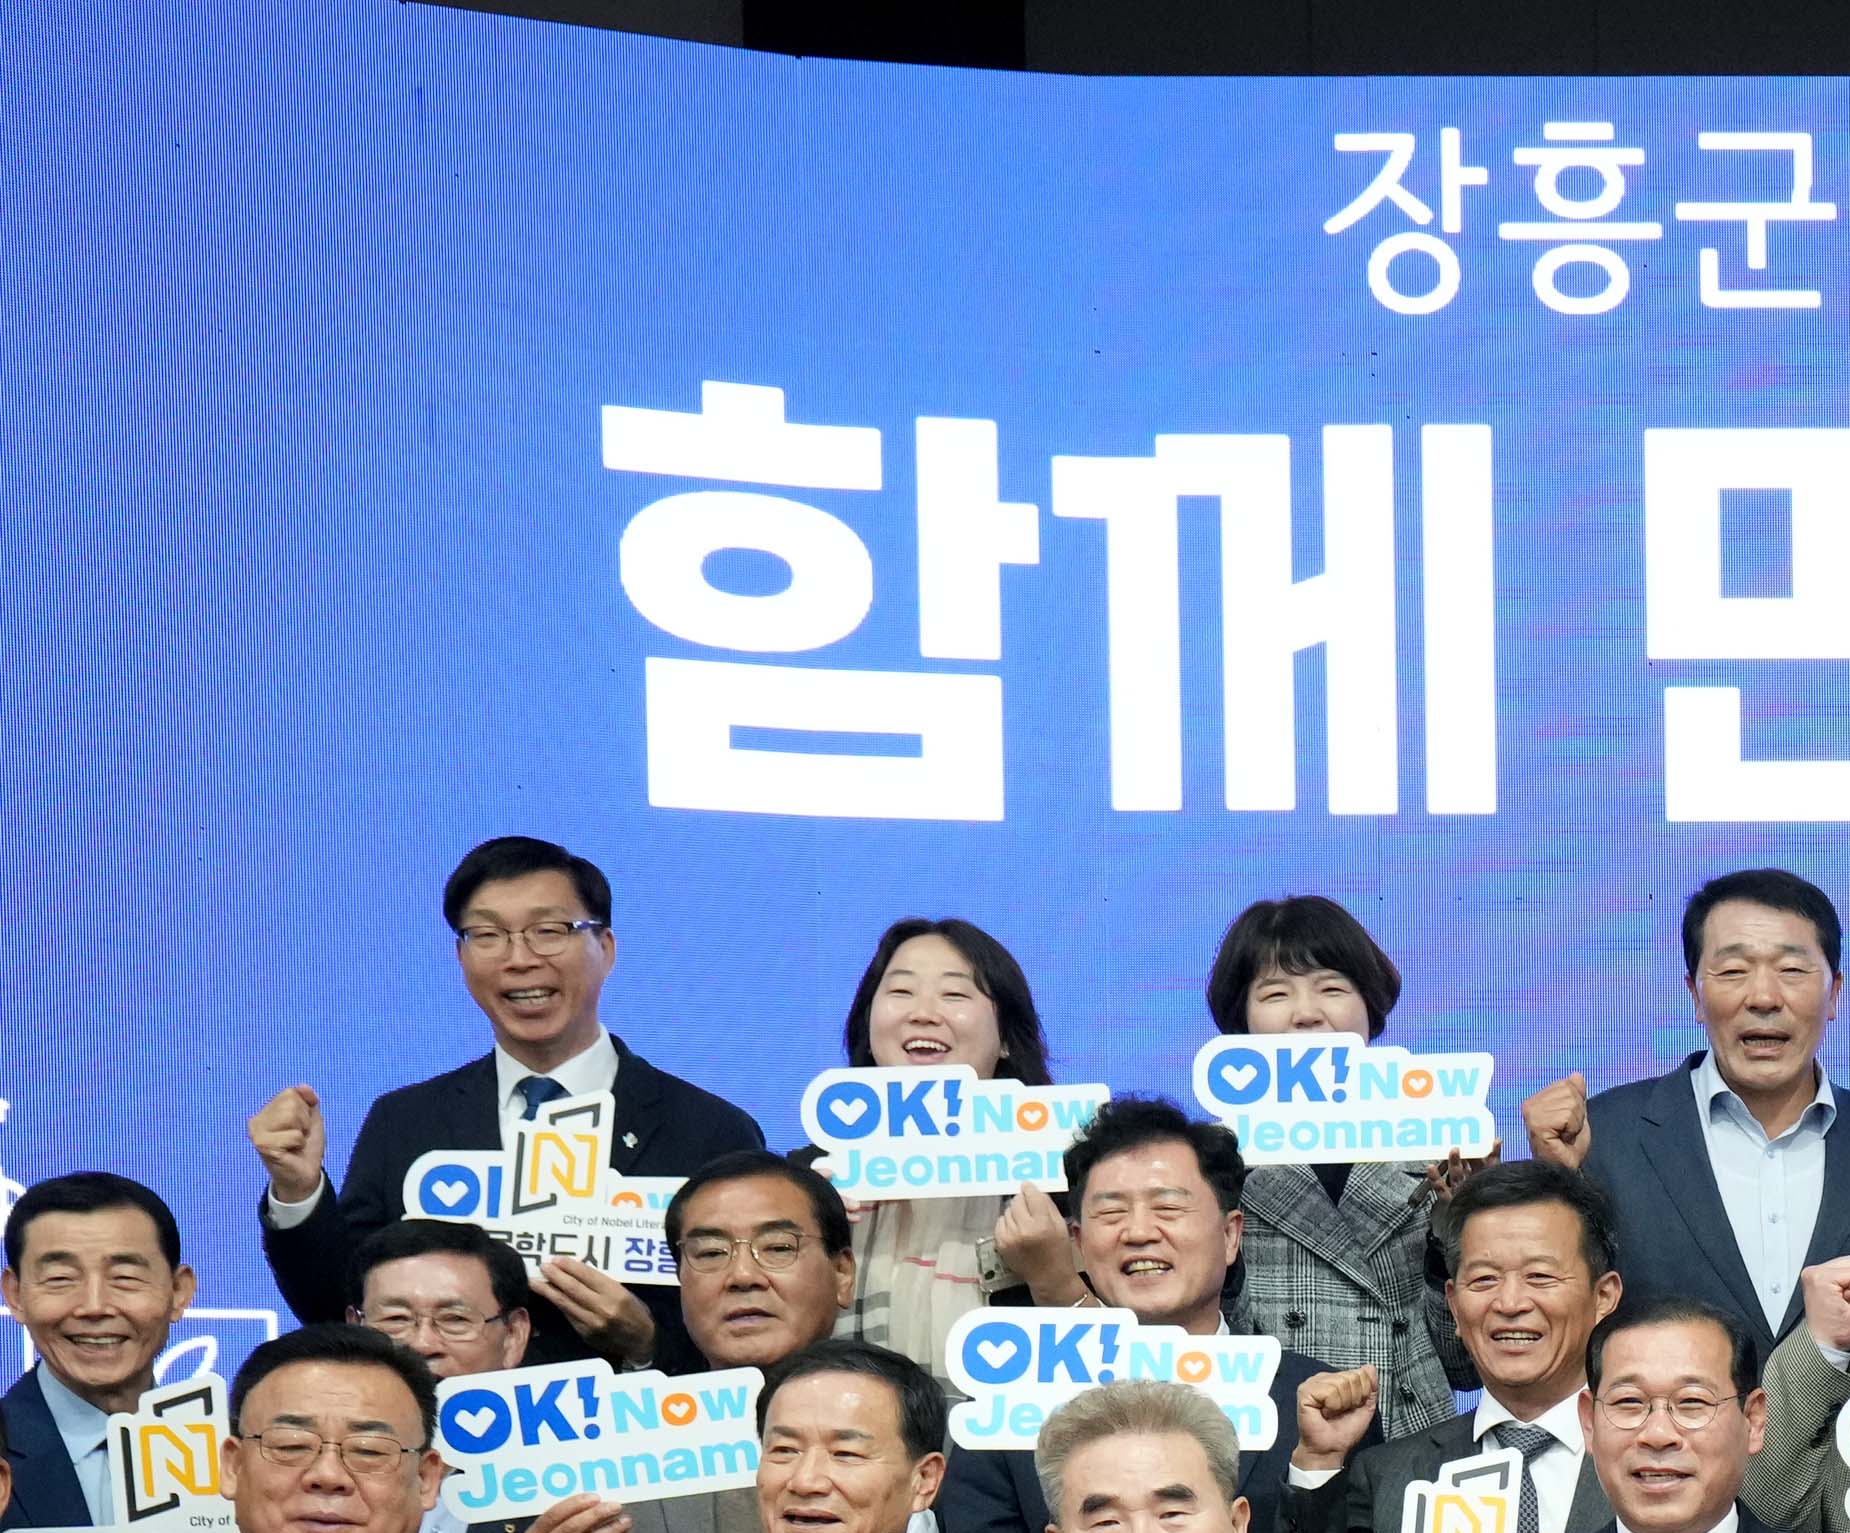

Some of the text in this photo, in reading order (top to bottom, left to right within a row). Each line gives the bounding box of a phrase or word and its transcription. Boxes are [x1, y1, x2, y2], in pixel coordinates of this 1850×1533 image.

[602, 381, 1496, 821] 함께
[1207, 1047, 1479, 1105] OK! Now
[816, 1079, 963, 1140] OK!
[1234, 1109, 1481, 1151] Jeonnam
[563, 1215, 582, 1226] City
[588, 1217, 598, 1225] of
[601, 1217, 633, 1227] Nobel
[962, 1322, 1264, 1385] OK! Now
[440, 1376, 747, 1453] OK! Now
[458, 1440, 758, 1508] Jeonnam
[189, 1515, 230, 1528] City of
